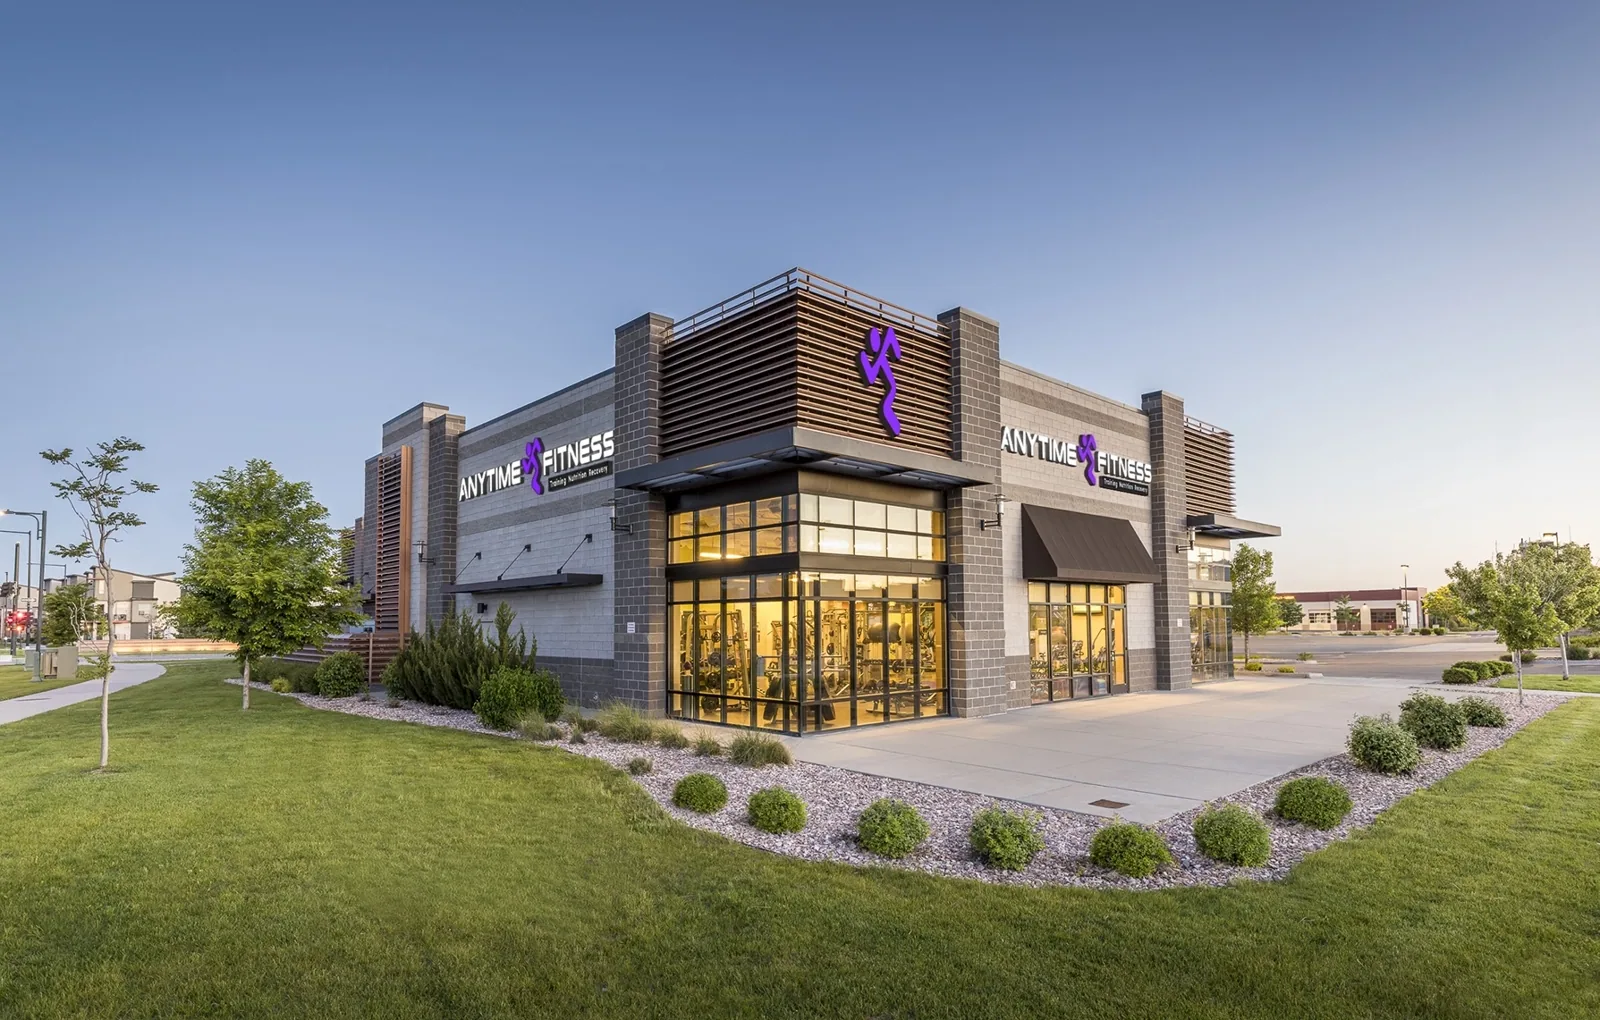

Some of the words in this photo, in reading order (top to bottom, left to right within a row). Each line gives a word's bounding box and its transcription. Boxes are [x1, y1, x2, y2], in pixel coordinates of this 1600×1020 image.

[458, 460, 522, 502] ANYTIME
[543, 430, 614, 475] FITNESS
[549, 477, 567, 487] Training
[568, 471, 587, 482] Nutrition
[588, 465, 608, 476] Recovery
[1001, 426, 1077, 465] ANYTIME
[1097, 451, 1152, 482] FITNESS
